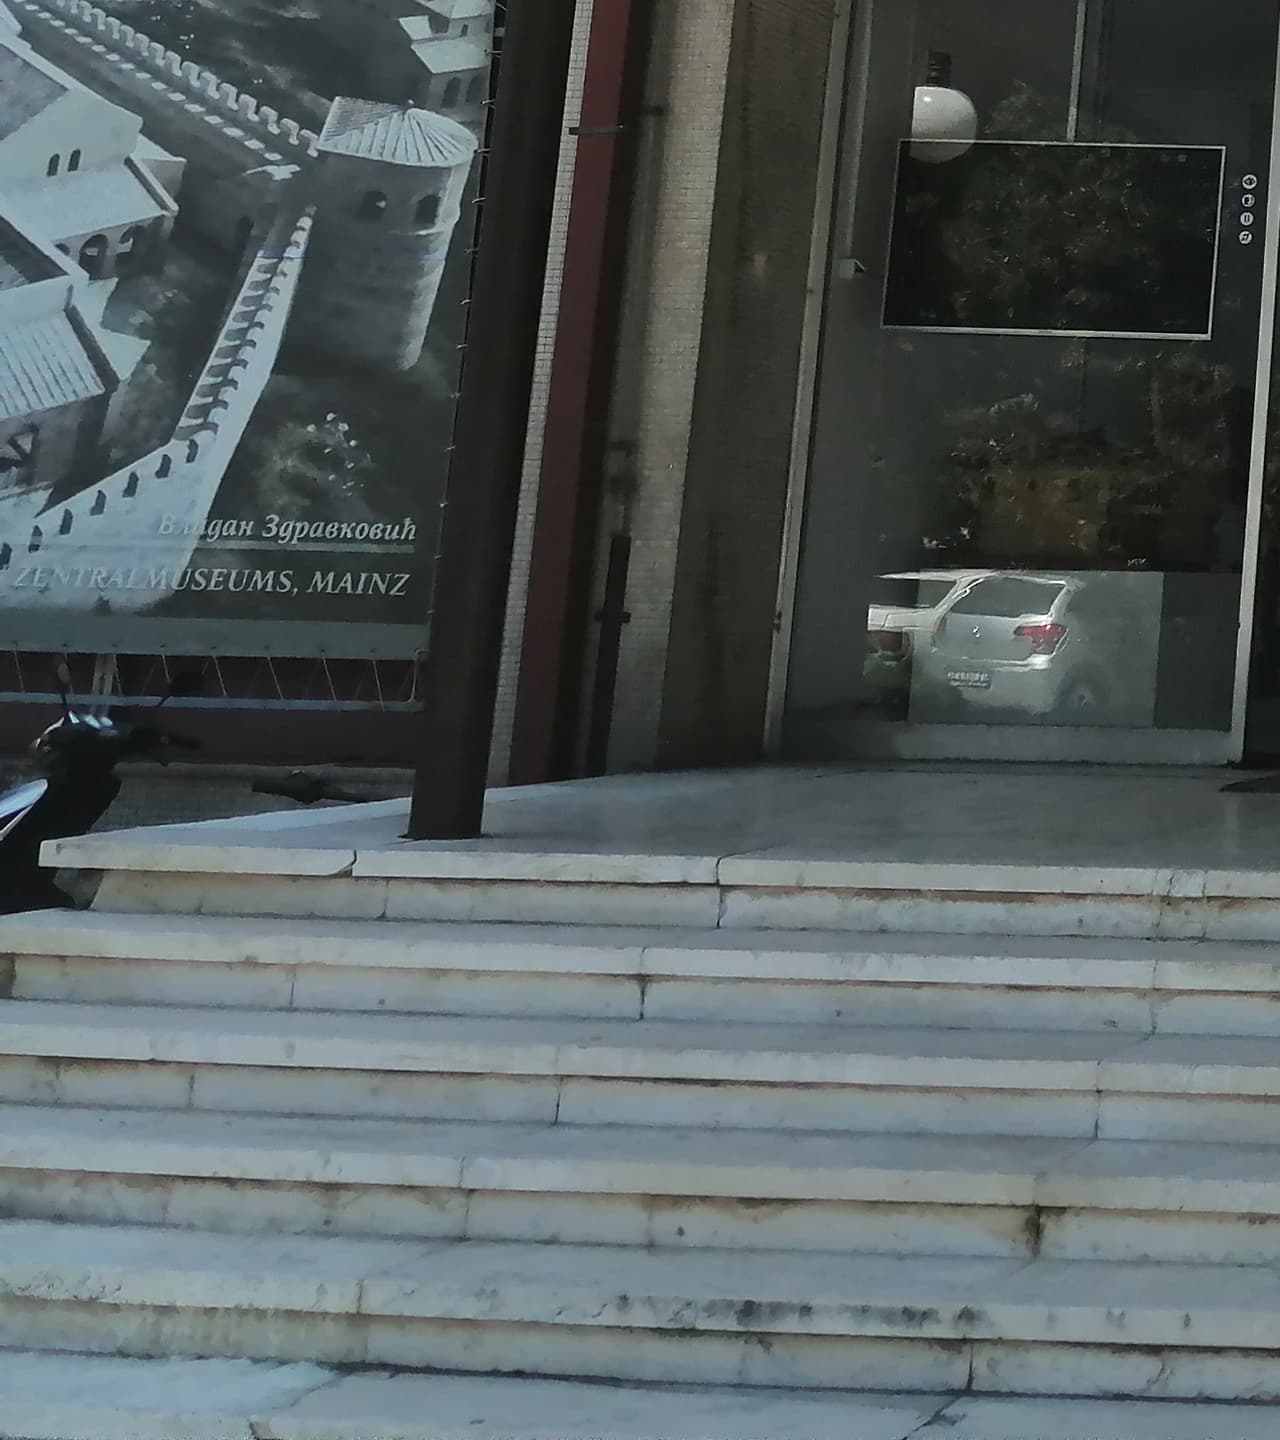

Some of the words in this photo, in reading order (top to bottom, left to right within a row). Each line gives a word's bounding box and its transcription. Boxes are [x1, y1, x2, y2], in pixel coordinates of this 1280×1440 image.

[262, 514, 417, 544] Здравковић
[14, 566, 298, 596] ZENTRALMUSEUMS,
[306, 571, 411, 596] MAINZ
